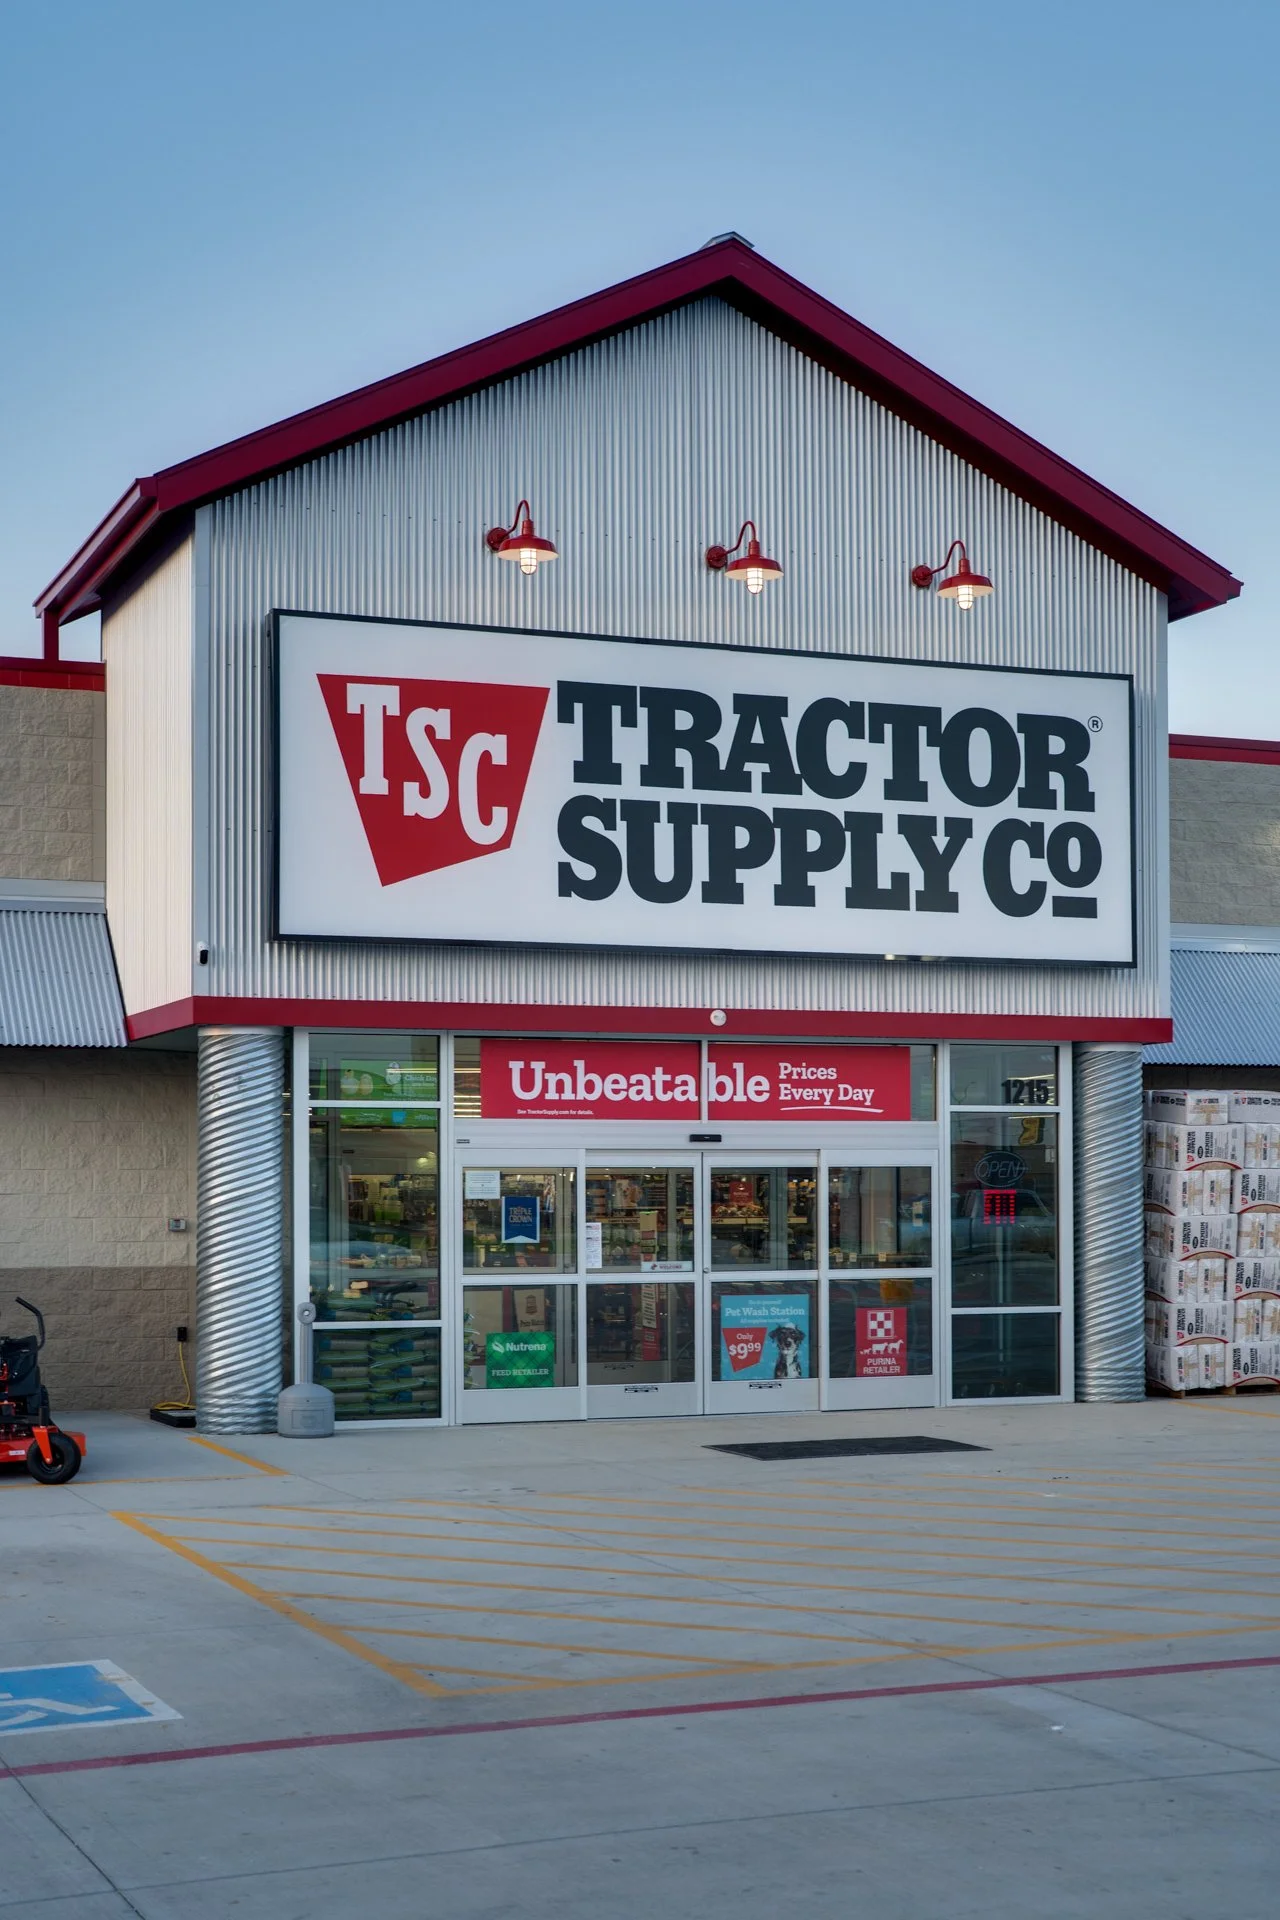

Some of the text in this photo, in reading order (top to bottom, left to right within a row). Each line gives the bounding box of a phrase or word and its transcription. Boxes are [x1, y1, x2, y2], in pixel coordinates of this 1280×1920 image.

[557, 680, 1095, 812] TRACTOR
[346, 682, 508, 845] TSC
[557, 794, 973, 913] SUPPLY
[779, 1062, 838, 1080] Prices
[508, 1059, 770, 1103] Unbeatable
[779, 1083, 875, 1105] Every Day
[1001, 1079, 1050, 1104] 1215
[977, 1160, 1020, 1178] OPEN
[508, 1215, 533, 1223] CROWN
[725, 1305, 805, 1317] Pet Wash Station
[736, 1333, 754, 1341] Only
[505, 1341, 547, 1352] Nutrena
[863, 1366, 901, 1375] RETAILER
[866, 1357, 897, 1366] PURINA
[491, 1368, 550, 1377] FEED RETAILER
